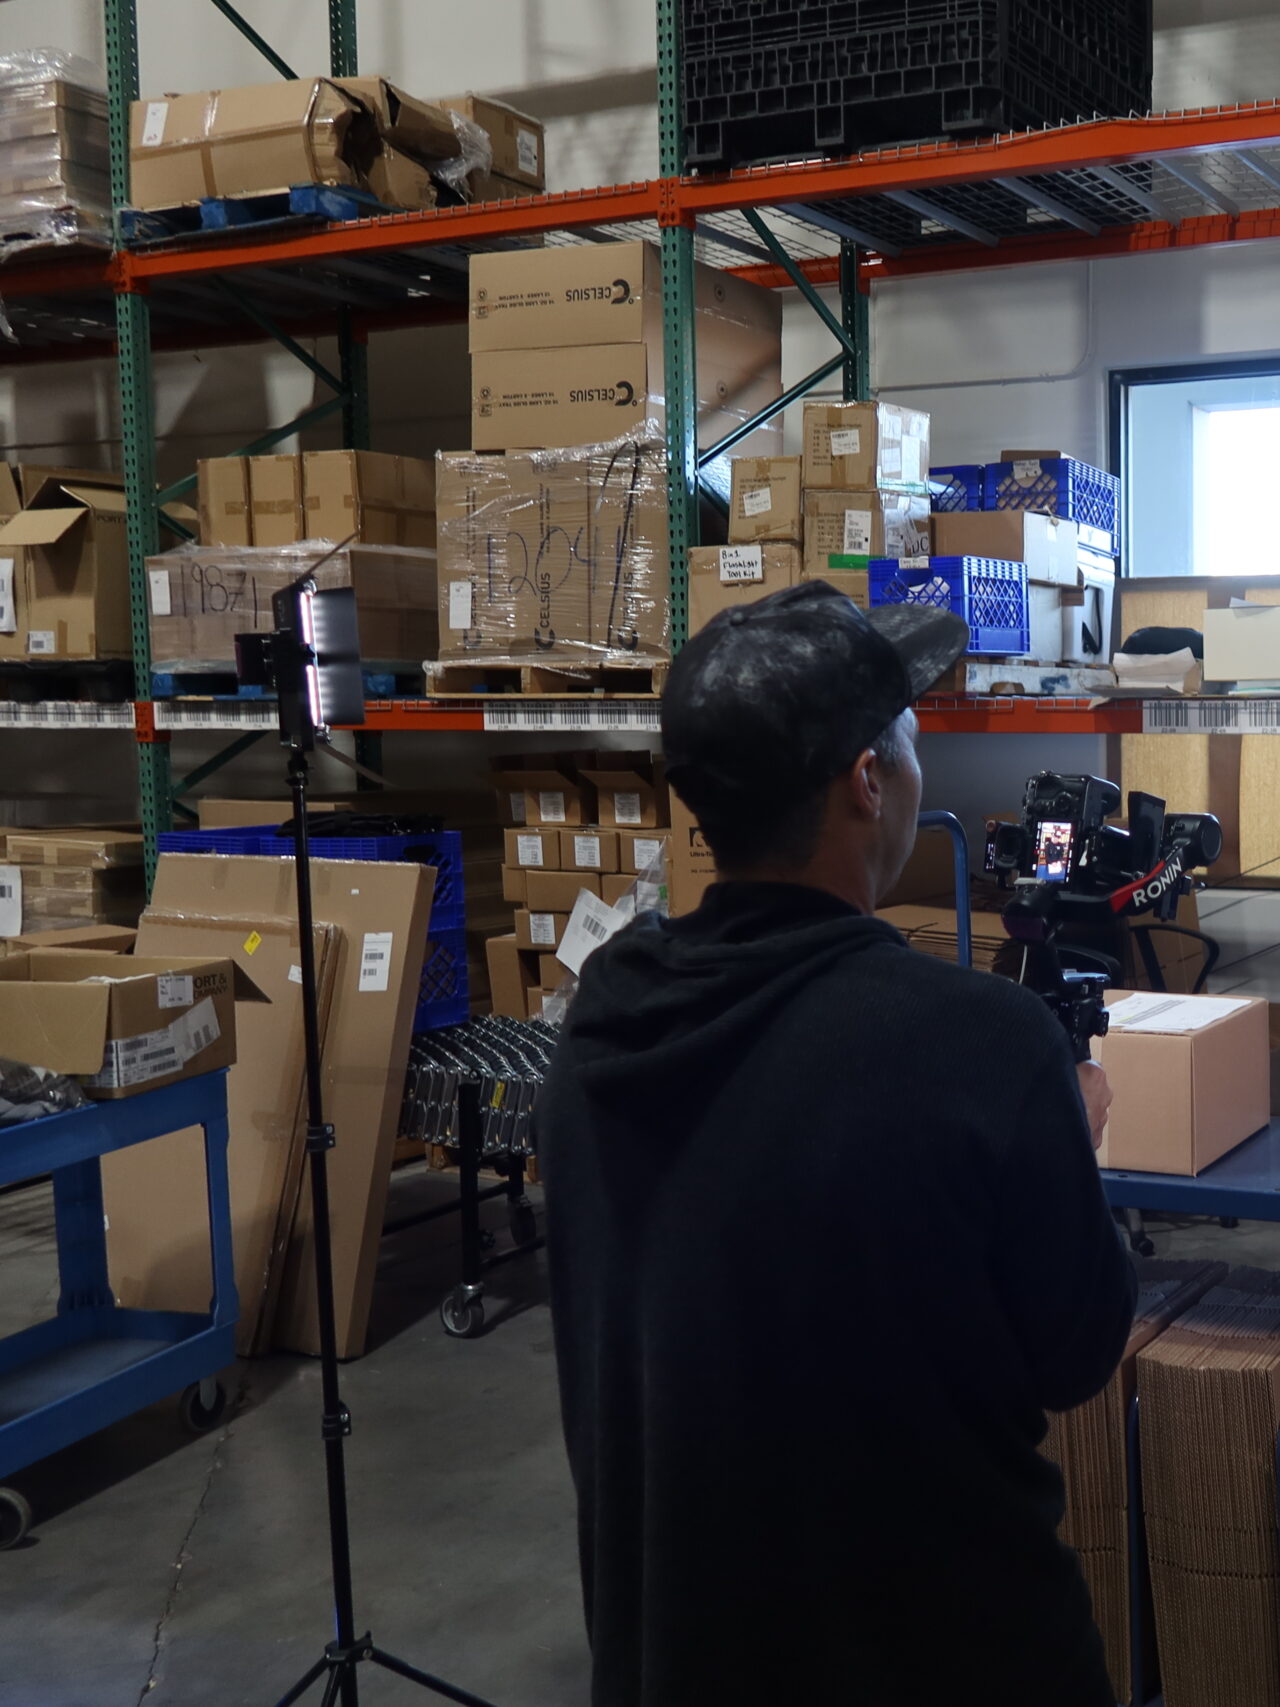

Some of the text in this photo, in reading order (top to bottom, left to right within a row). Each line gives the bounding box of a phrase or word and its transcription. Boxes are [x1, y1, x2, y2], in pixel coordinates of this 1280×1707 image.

[565, 286, 611, 302] CELSIUS
[570, 388, 616, 403] CELSIUS
[540, 572, 550, 628] CELSIUS
[1132, 856, 1183, 907] RONIN
[193, 974, 217, 989] ORT
